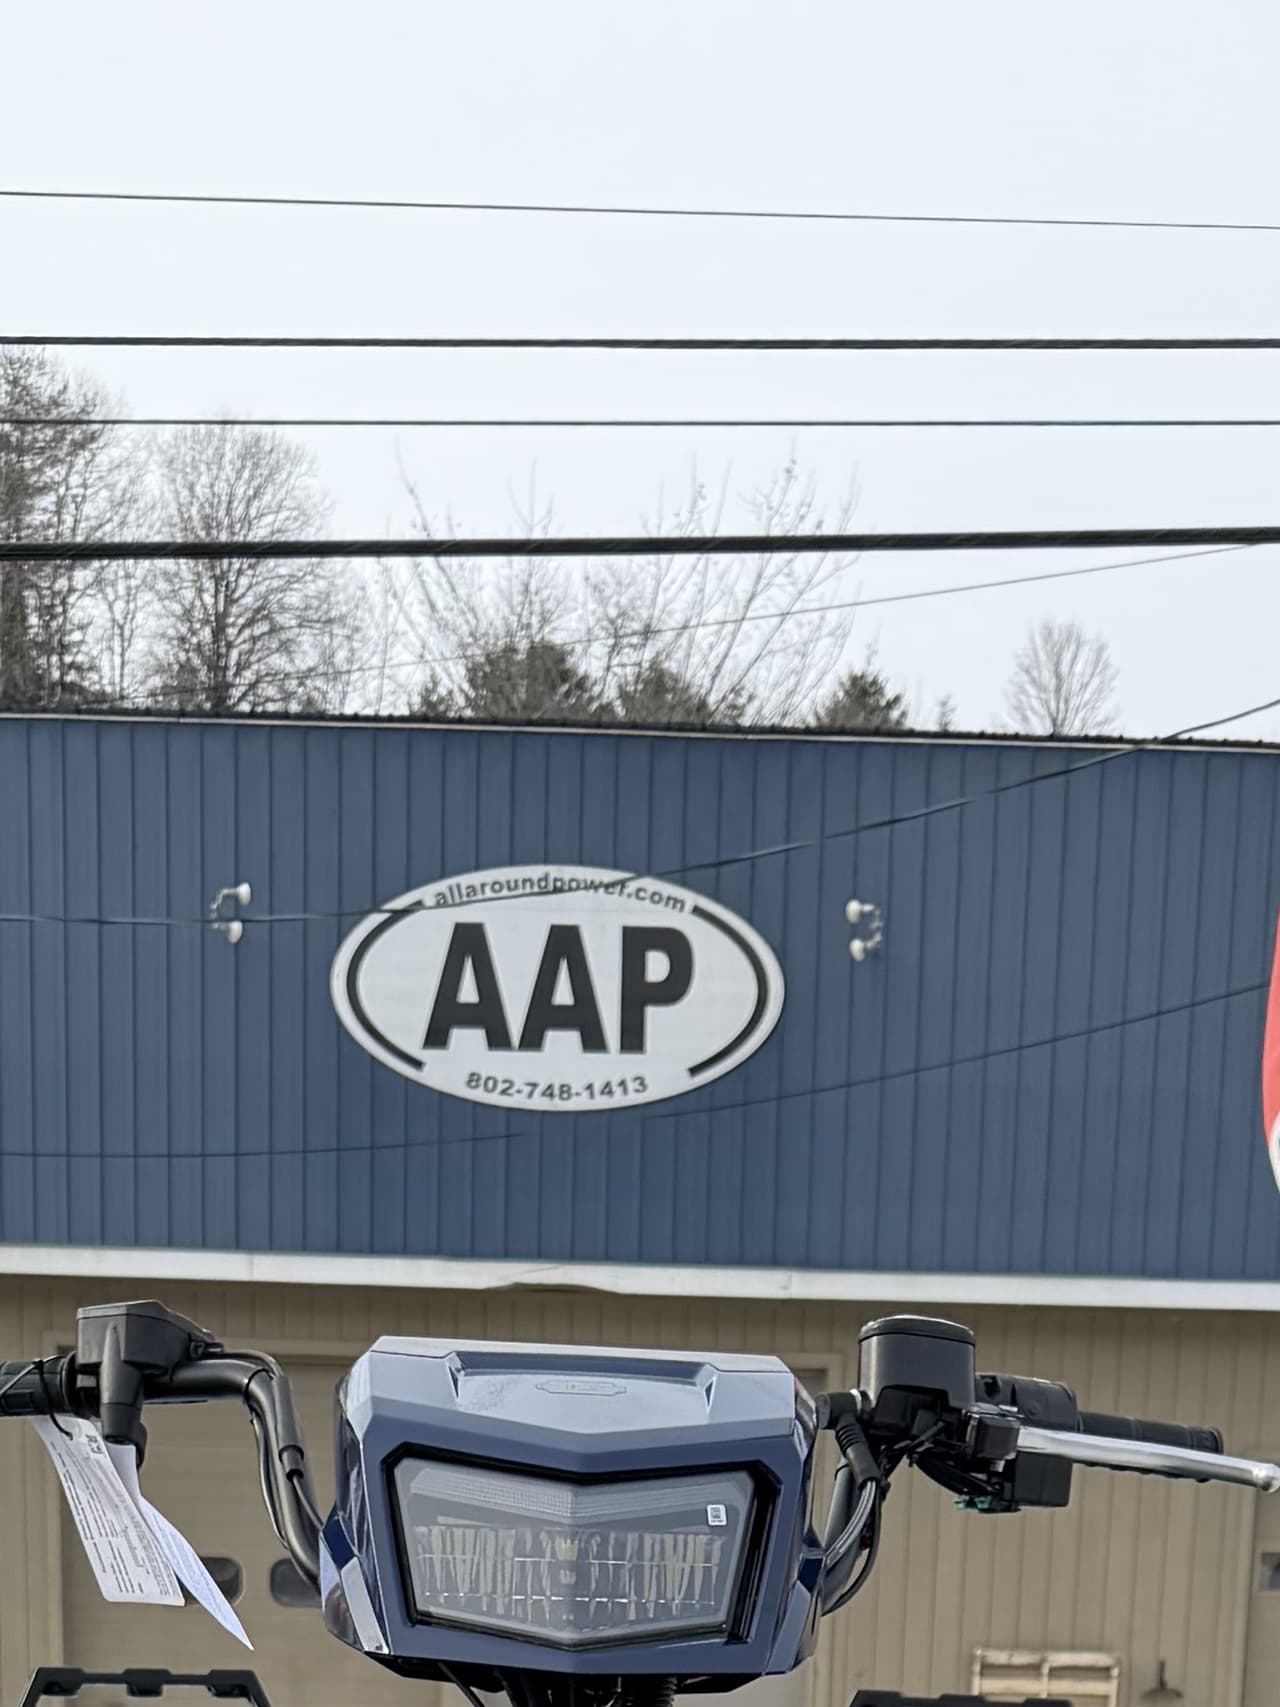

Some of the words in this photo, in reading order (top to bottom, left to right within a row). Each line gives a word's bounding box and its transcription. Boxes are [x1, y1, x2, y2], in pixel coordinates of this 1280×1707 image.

[435, 872, 686, 912] allaroundpower.com
[422, 922, 695, 1054] AAP
[465, 1071, 648, 1101] 802-748-1413
